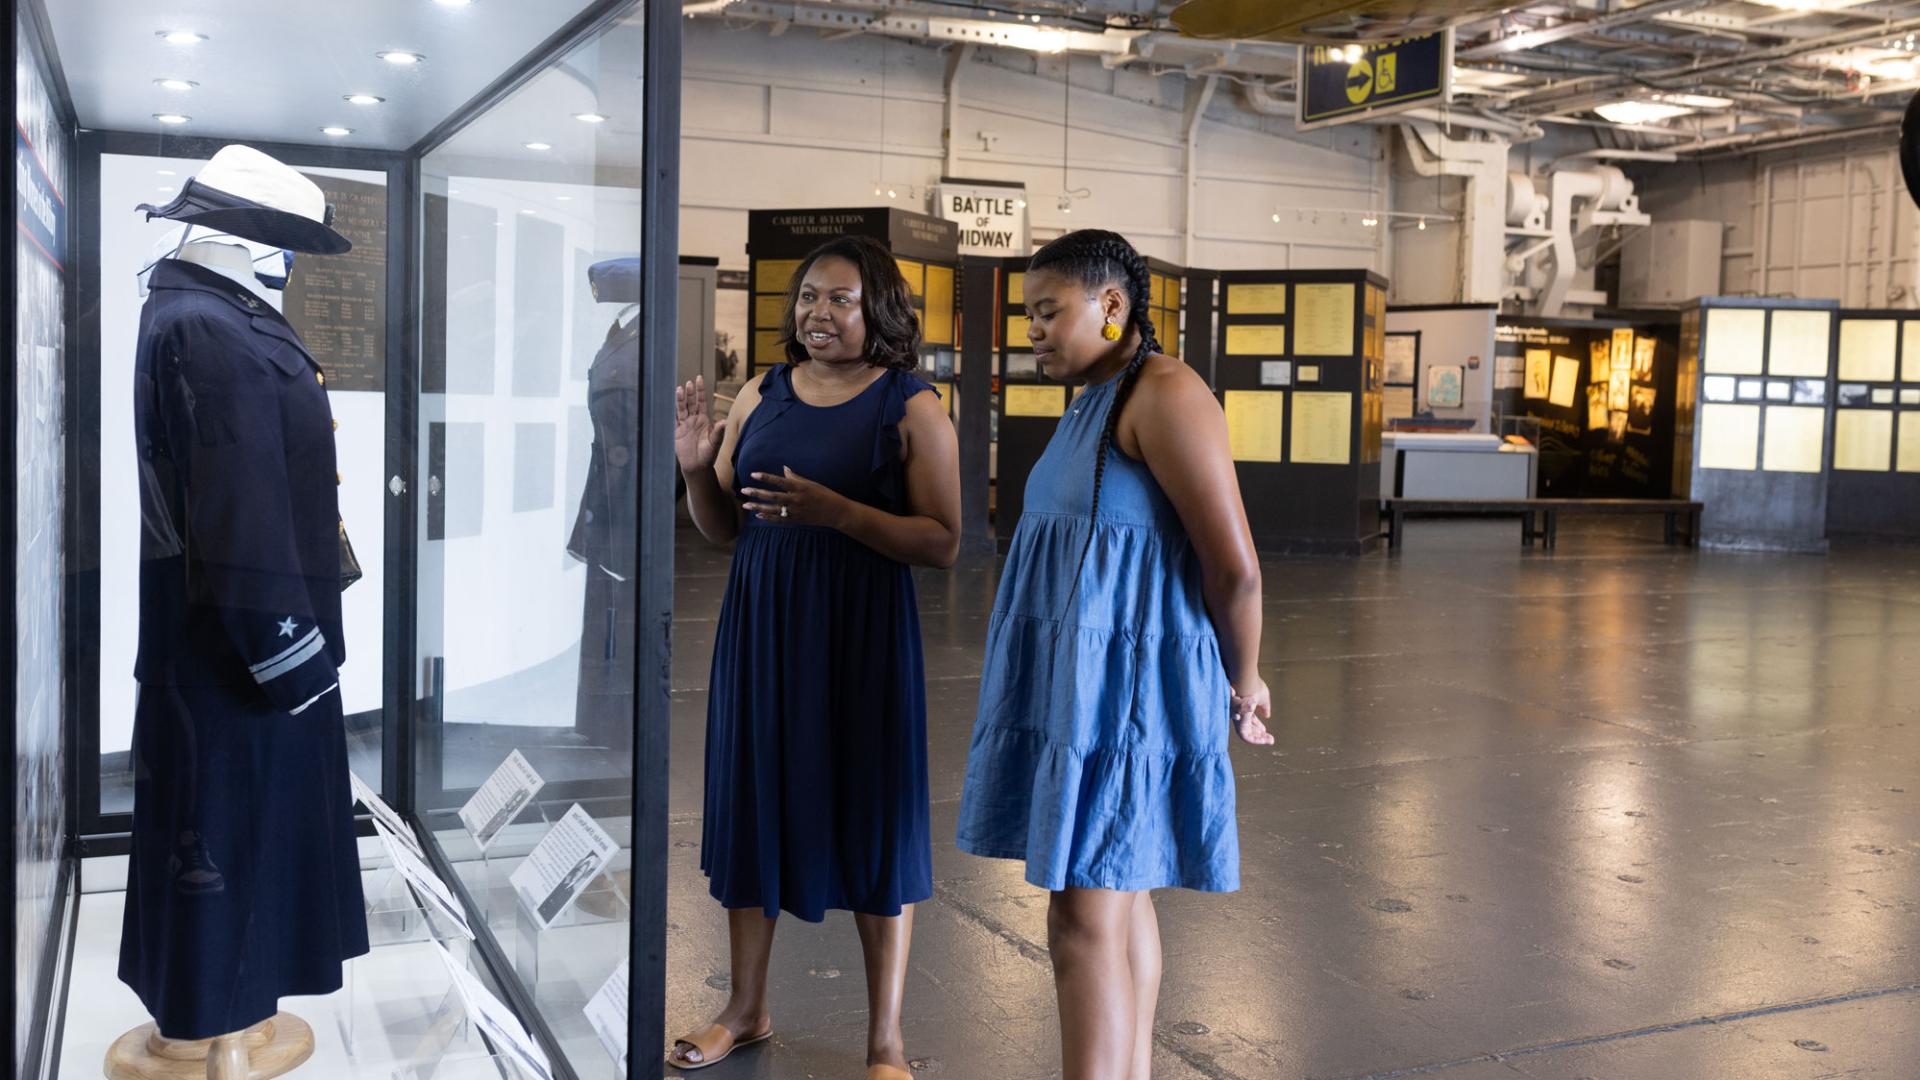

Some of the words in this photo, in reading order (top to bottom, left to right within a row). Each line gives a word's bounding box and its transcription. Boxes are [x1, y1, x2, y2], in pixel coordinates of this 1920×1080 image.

[953, 196, 1013, 216] BATTLE
[772, 215, 815, 226] CARRIER
[819, 214, 865, 225] AVIATION
[976, 216, 990, 228] OF
[790, 225, 846, 236] MEMORIAL
